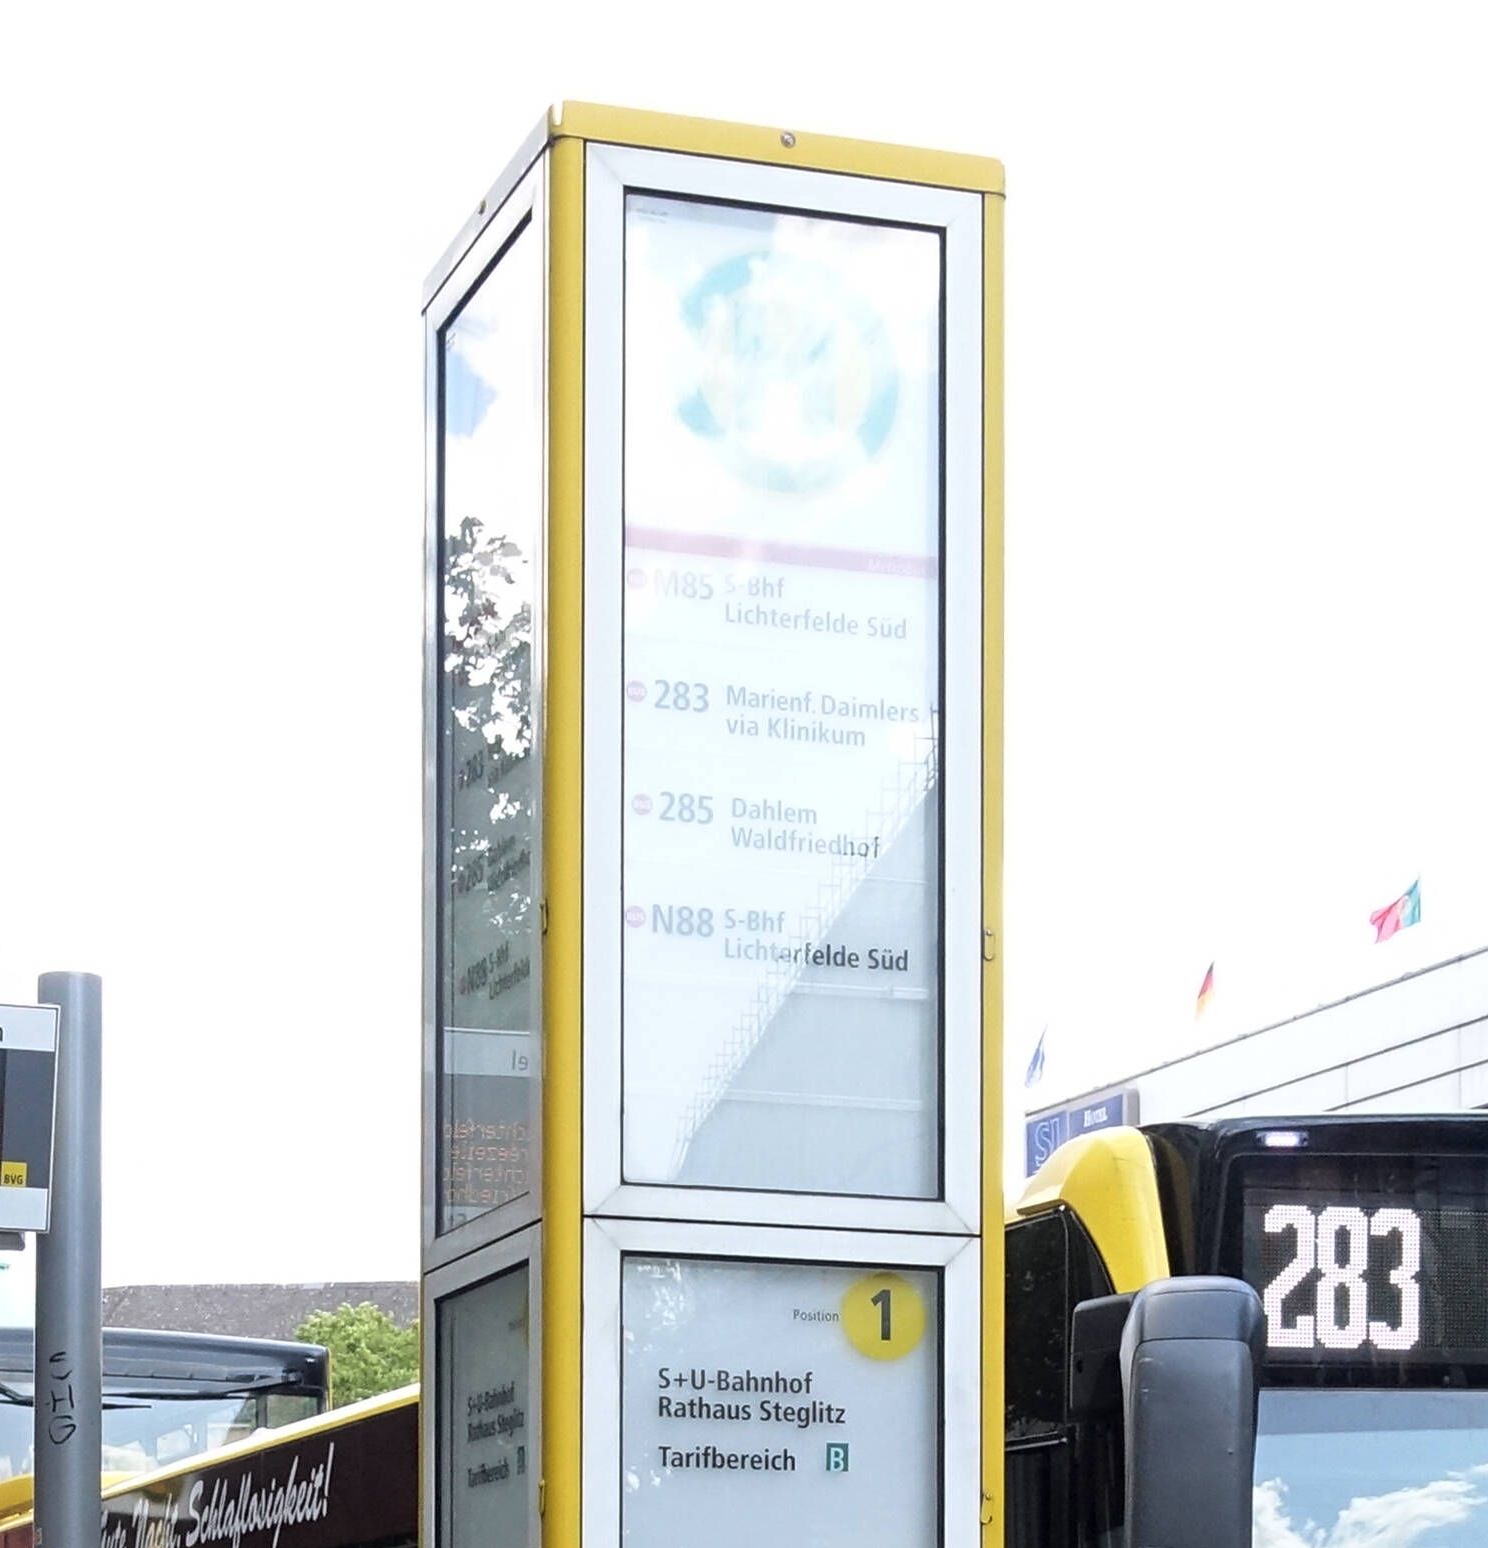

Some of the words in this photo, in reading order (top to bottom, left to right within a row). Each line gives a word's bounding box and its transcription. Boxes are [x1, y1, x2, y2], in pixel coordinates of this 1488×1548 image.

[725, 602, 858, 635] Lichterfelde
[867, 616, 907, 640] Süd
[654, 679, 710, 713] 283
[726, 684, 816, 715] Marienf.
[821, 694, 920, 724] Daimlers
[726, 716, 759, 736] via
[767, 717, 866, 747] Klinikum
[659, 791, 714, 825] 285
[732, 798, 818, 825] Dahlem
[732, 826, 881, 859] Waldfriedhof
[652, 904, 715, 939] N88
[724, 908, 786, 935] S-Bhf
[724, 937, 860, 969] Lichterfelde
[868, 948, 909, 972] Süd
[4, 1174, 23, 1185] BVG
[1263, 1204, 1420, 1351] 283
[794, 1309, 839, 1322] Position
[871, 1289, 891, 1341] 1
[658, 1368, 813, 1394] S+U-Bahnhof
[658, 1397, 751, 1421] Rathaus
[759, 1400, 846, 1429] Steglitz
[658, 1446, 796, 1471] Tarifbereich
[829, 1447, 845, 1469] B
